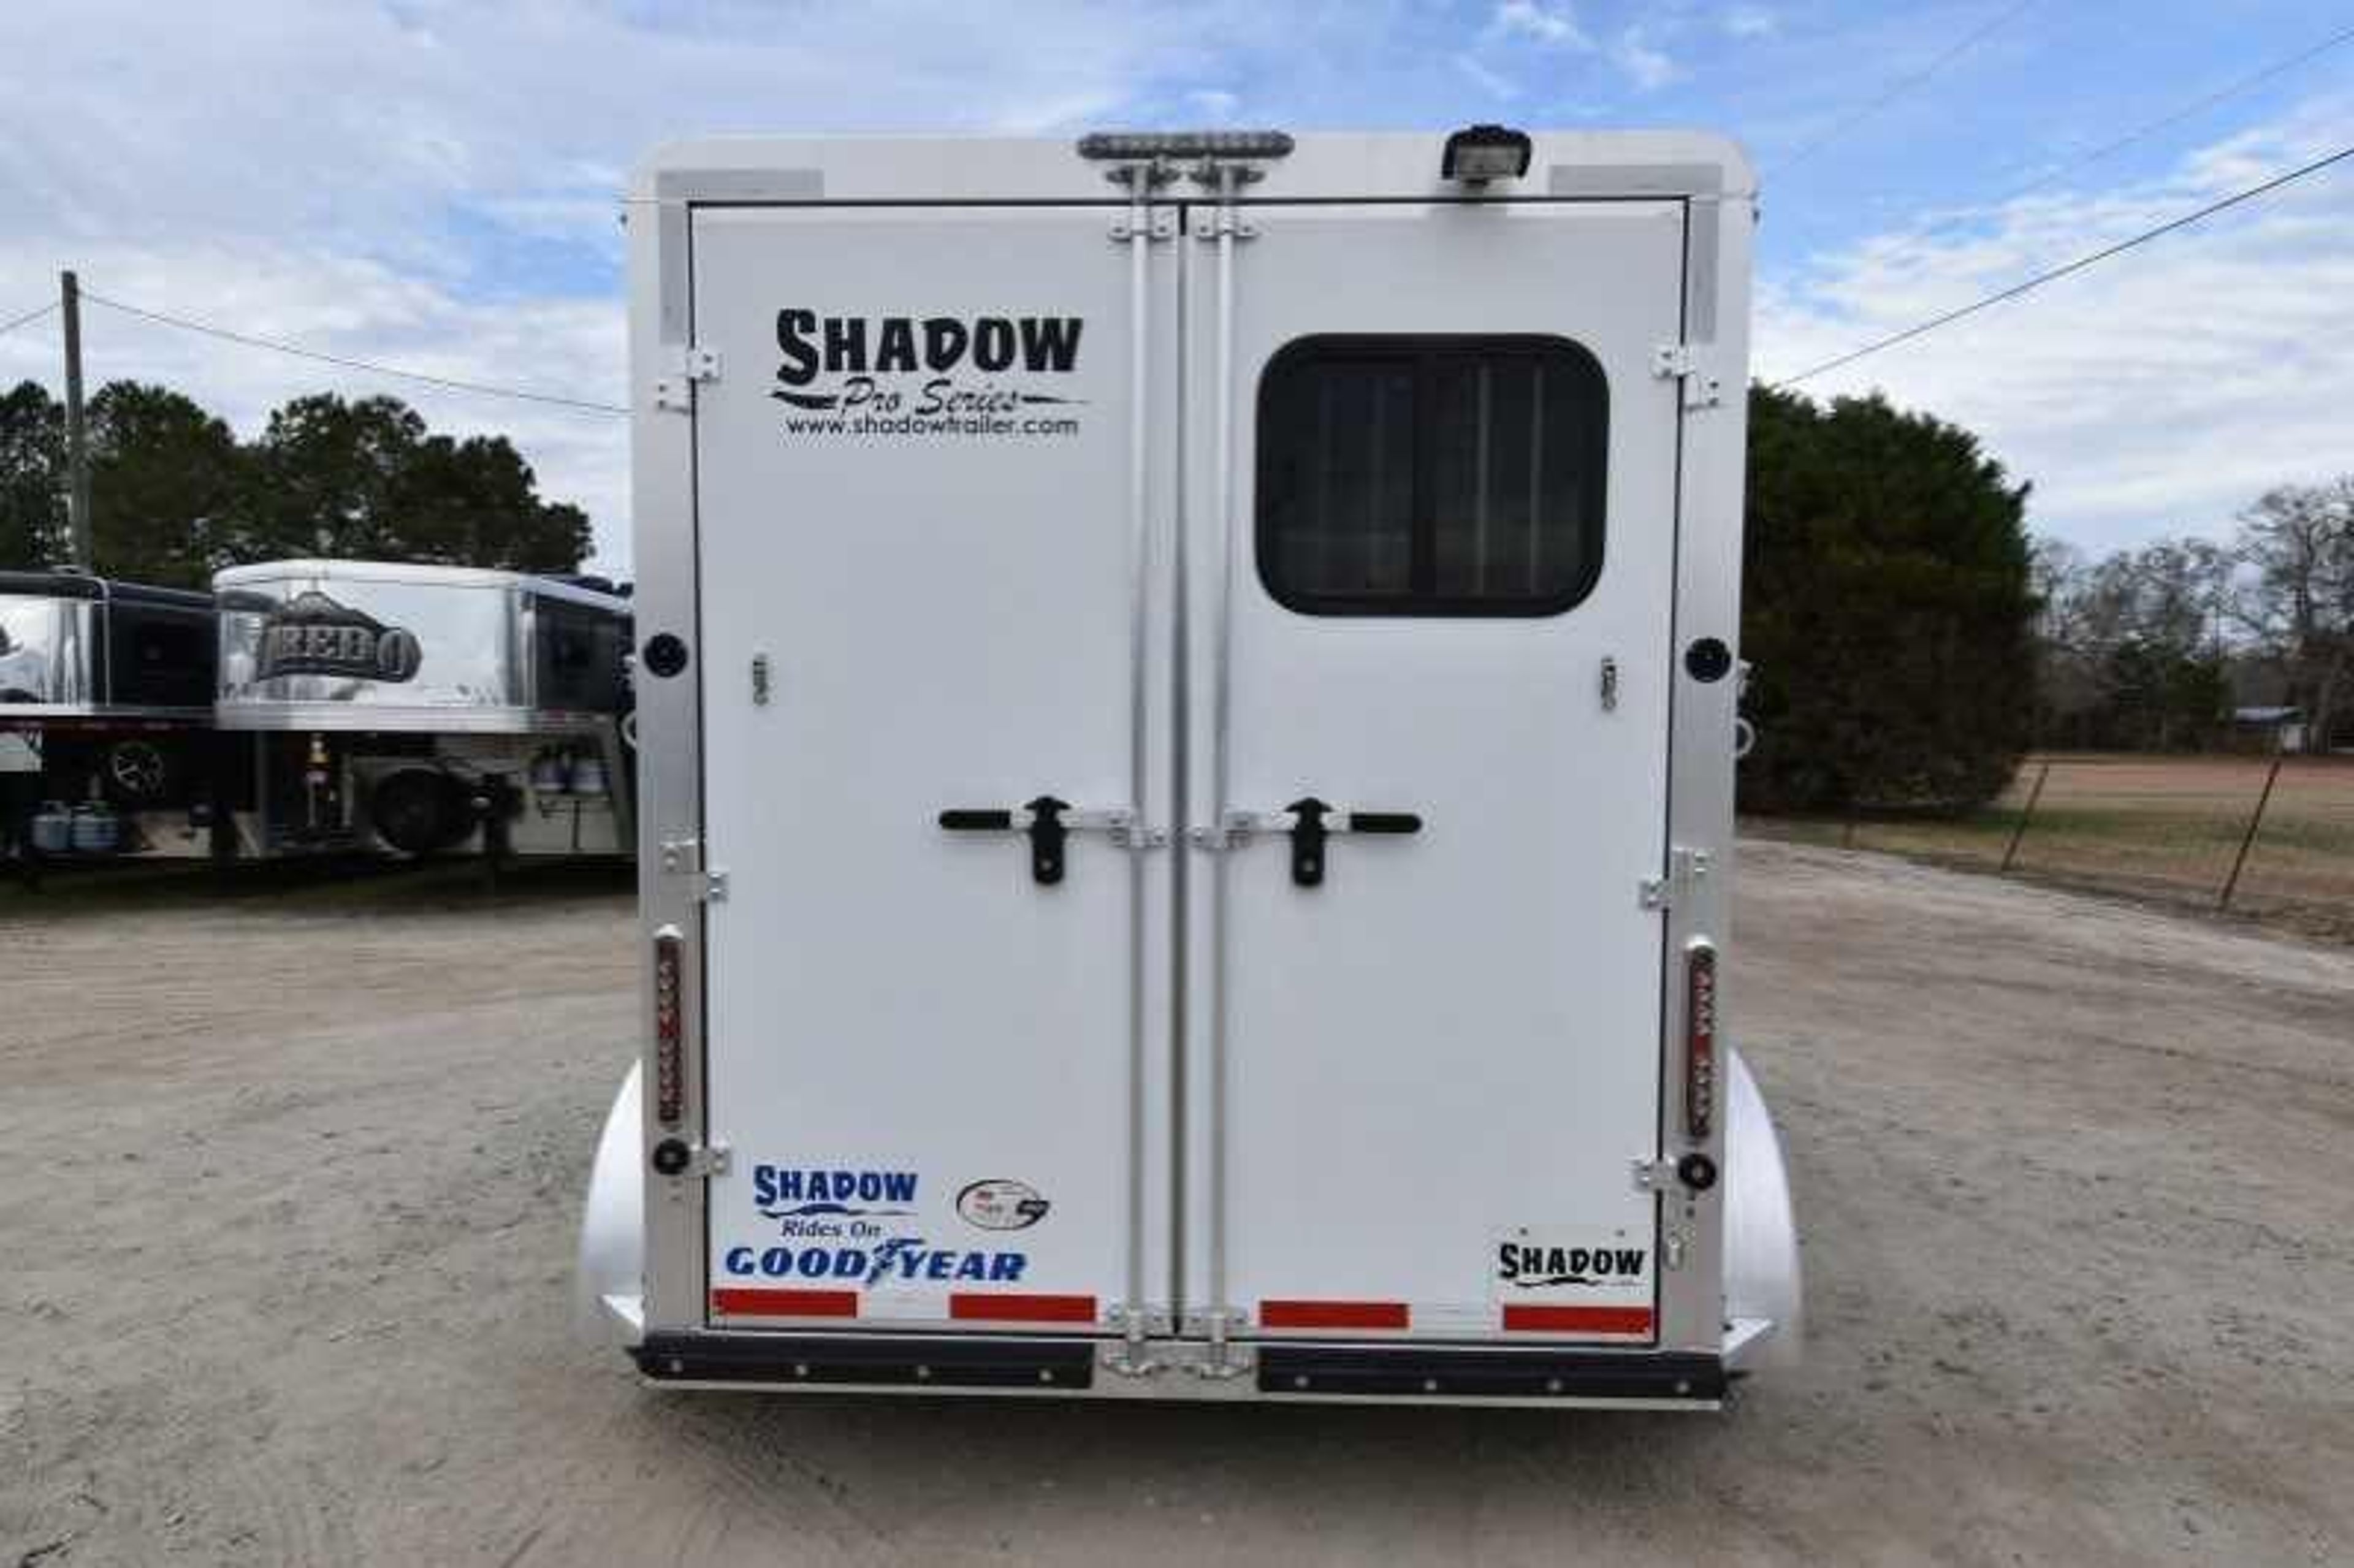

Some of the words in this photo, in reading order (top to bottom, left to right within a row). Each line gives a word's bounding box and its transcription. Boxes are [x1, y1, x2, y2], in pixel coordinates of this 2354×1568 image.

[776, 308, 1083, 386] SHADOW
[840, 376, 900, 412] Pro
[915, 379, 1018, 415] Series
[785, 415, 1079, 434] www.shadowtrailer.com
[754, 1165, 918, 1206] SHADOW
[780, 1220, 842, 1238] Rides
[850, 1221, 882, 1238] On
[726, 1246, 1027, 1281] GOODYEAR
[1499, 1243, 1645, 1278] SHADOW
